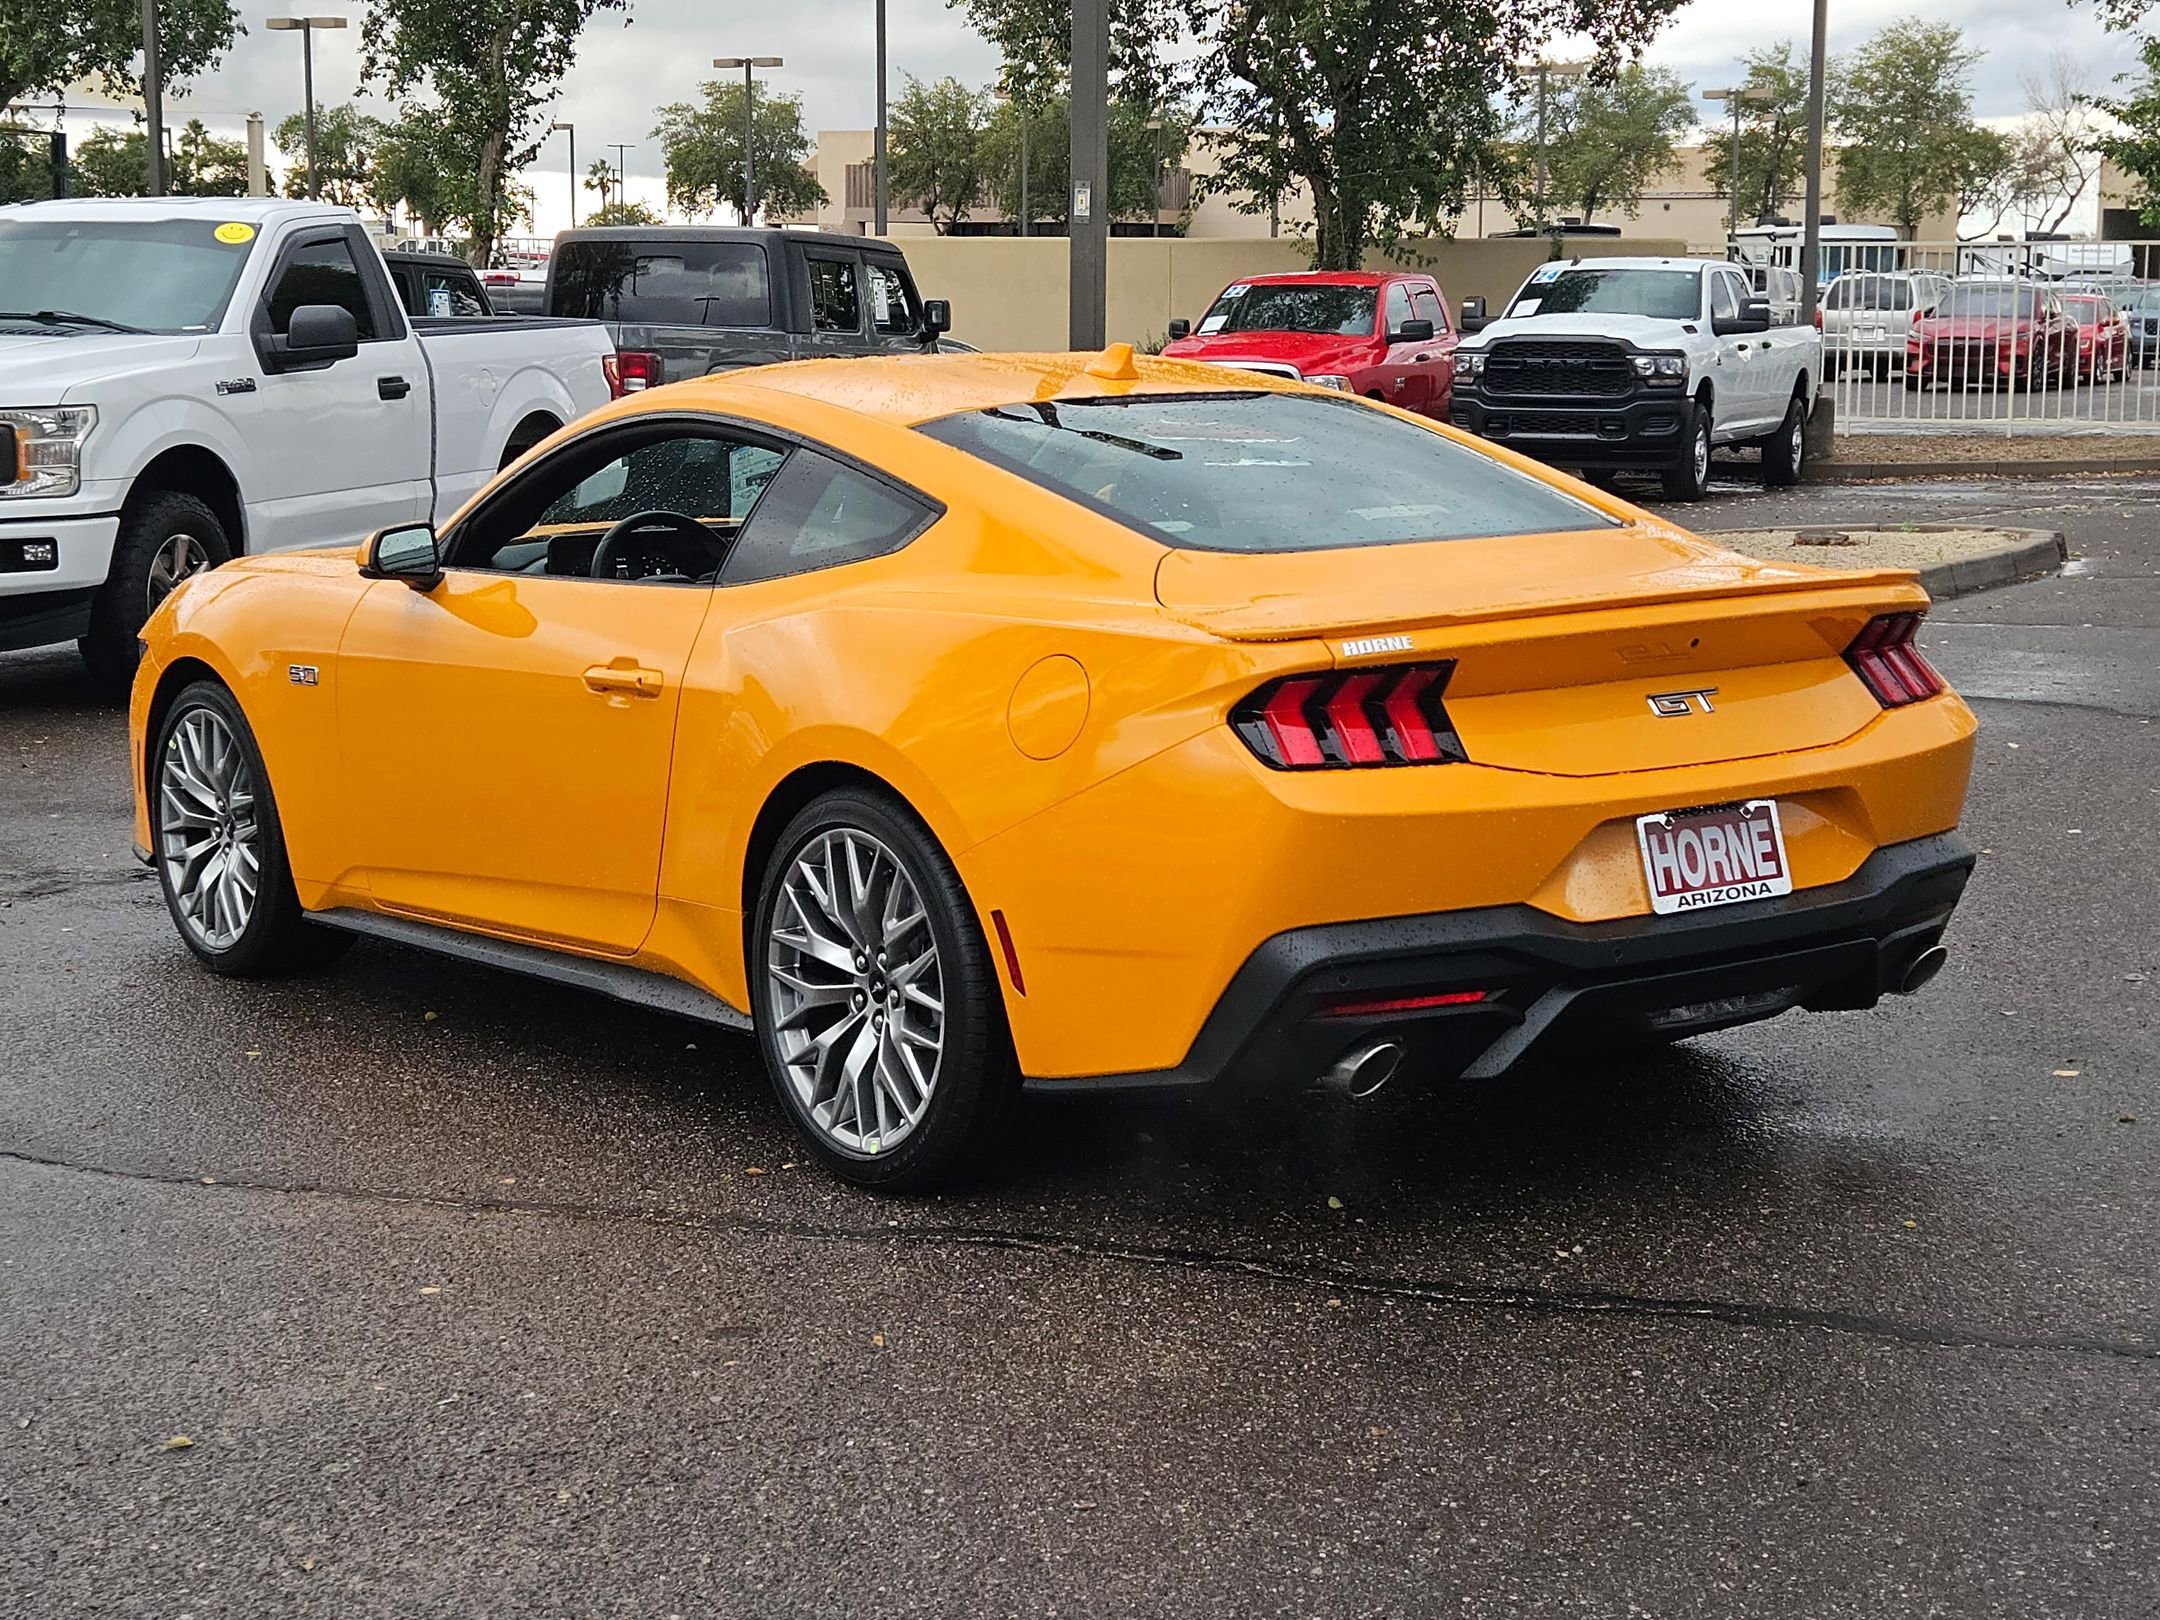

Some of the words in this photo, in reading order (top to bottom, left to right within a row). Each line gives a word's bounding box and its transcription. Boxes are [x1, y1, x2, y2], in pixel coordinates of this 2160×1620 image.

[1343, 635, 1414, 657] HORNE
[1646, 687, 1719, 718] GT
[1650, 819, 1777, 892] HORNE
[1678, 882, 1772, 908] ARIZONA
